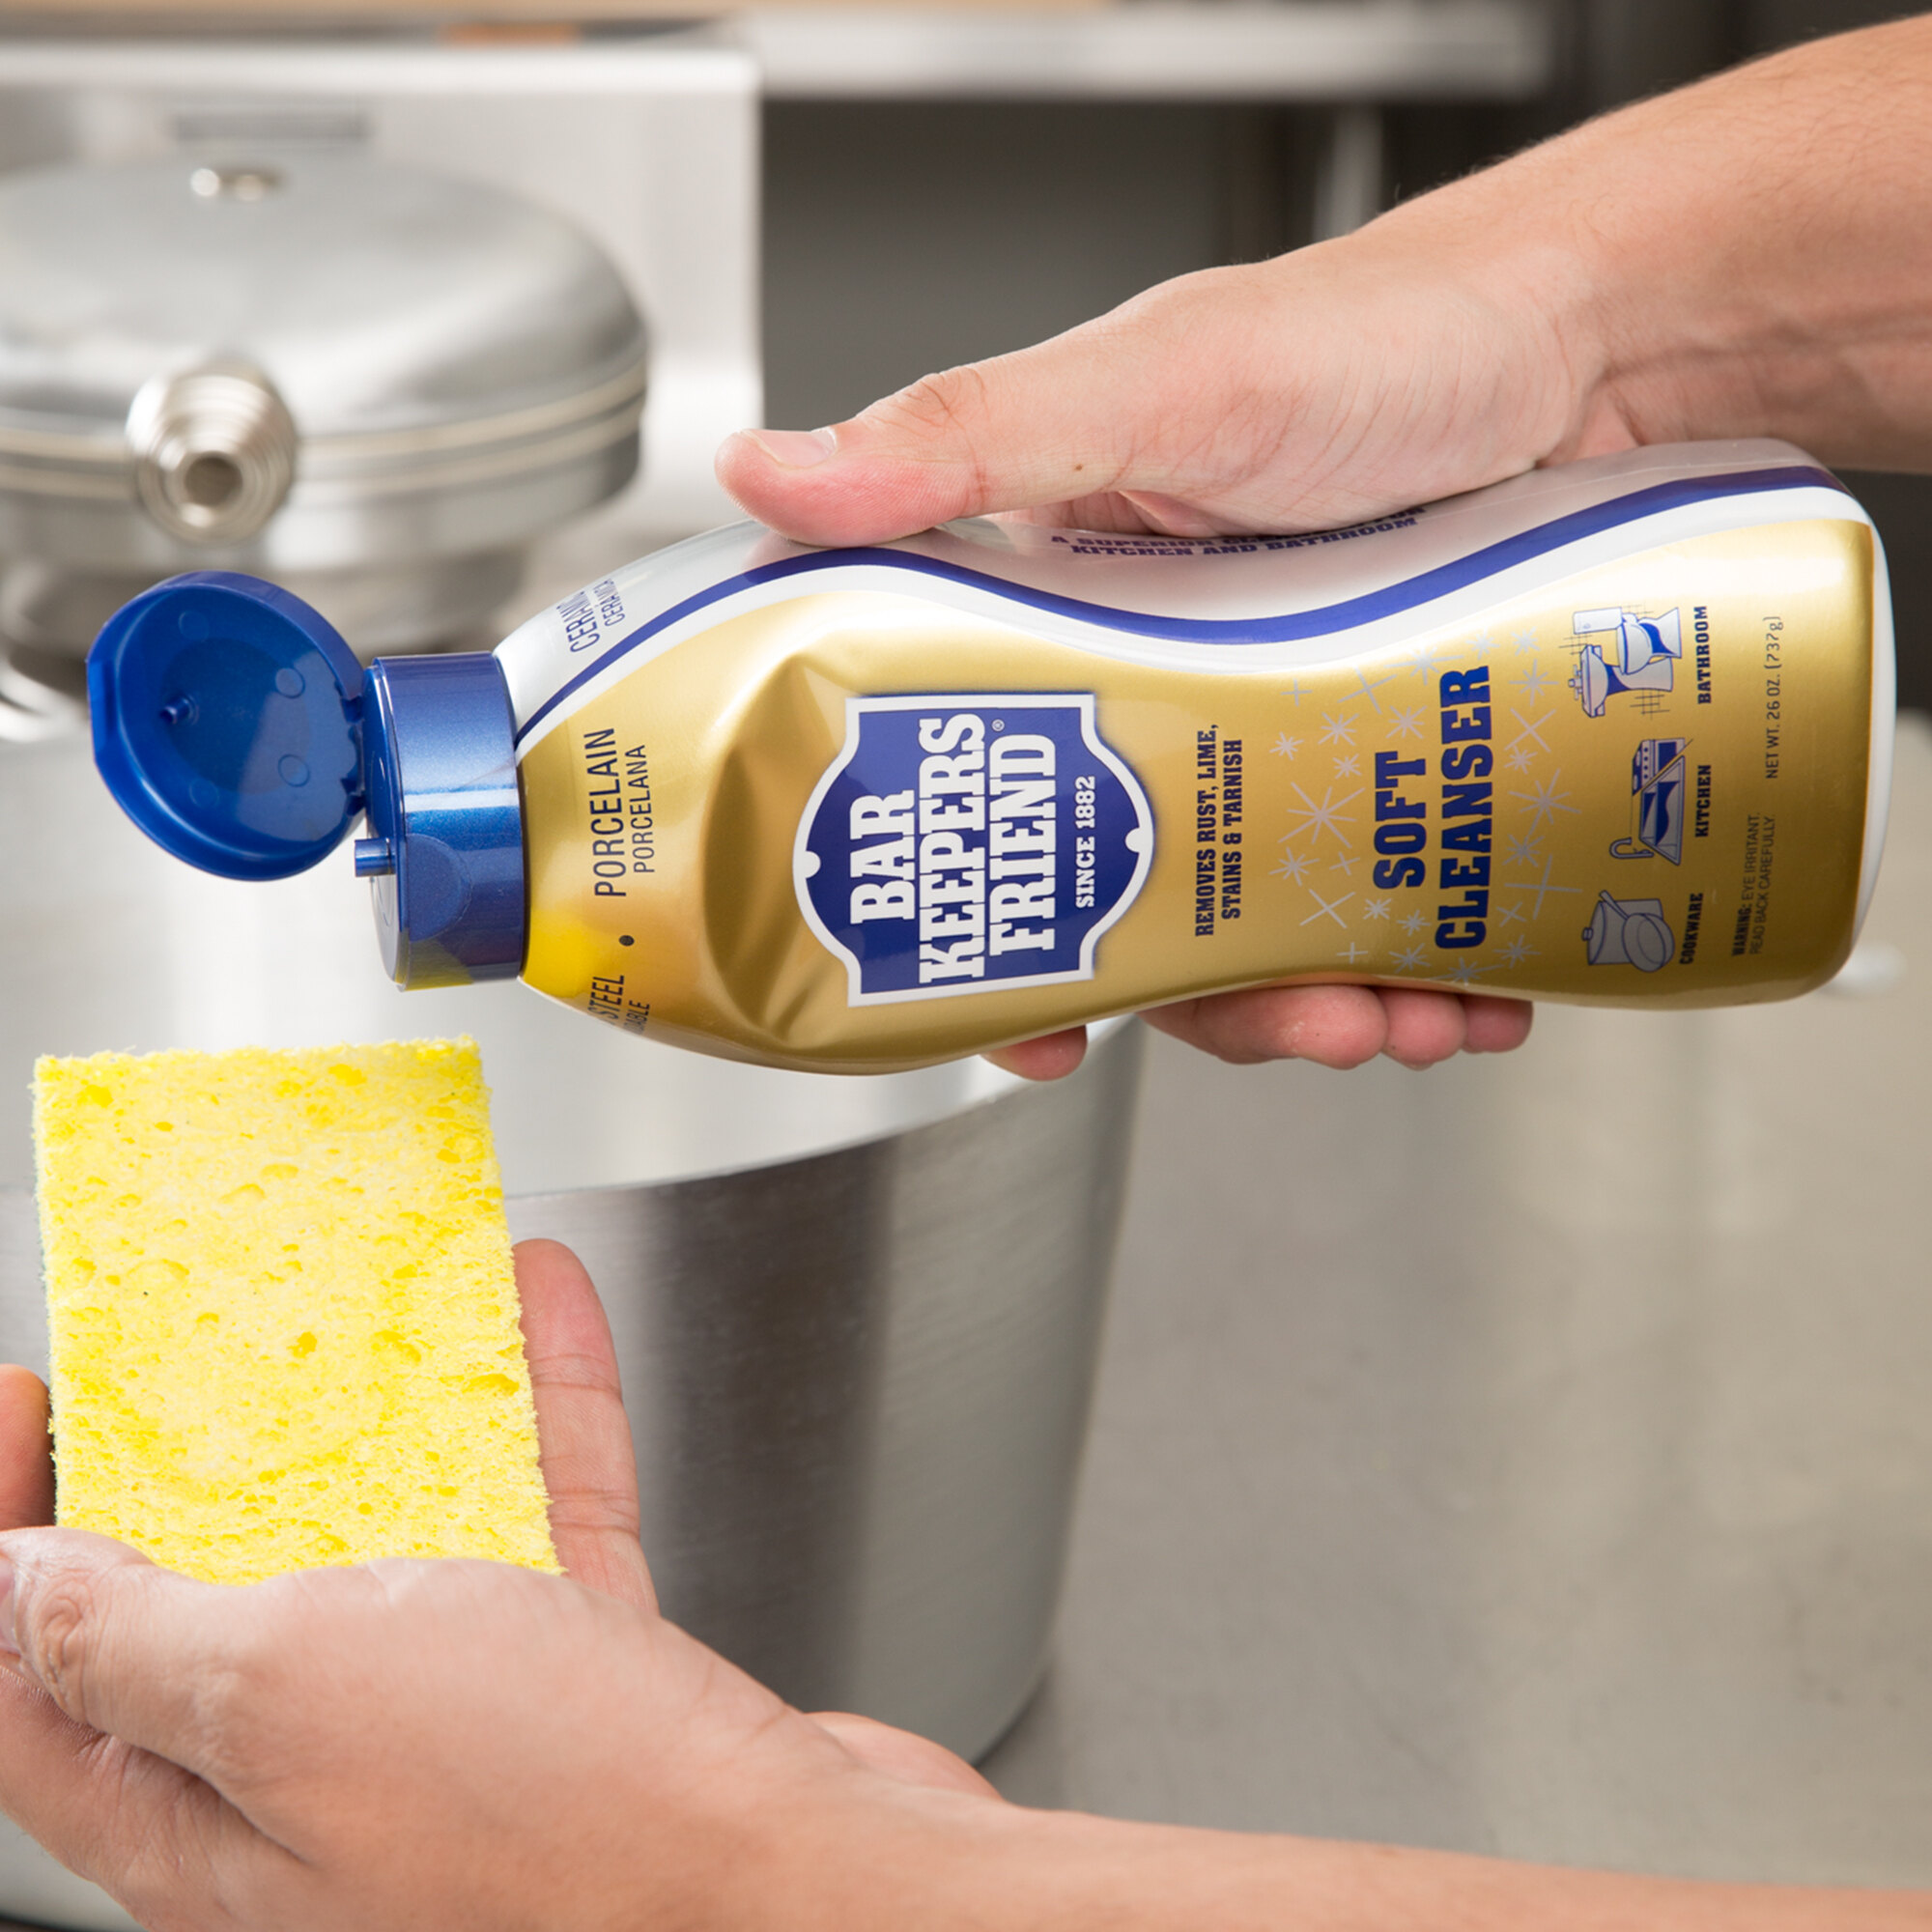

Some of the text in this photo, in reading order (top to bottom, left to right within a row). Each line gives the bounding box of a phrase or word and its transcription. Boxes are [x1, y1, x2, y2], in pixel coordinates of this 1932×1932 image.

[1070, 545, 1194, 556] KITCHEN
[1203, 543, 1258, 556] AND
[1265, 517, 1418, 551] BATHROOM
[1076, 537, 1213, 548] SUPERIOR
[1693, 606, 1712, 704] BATHROOM
[1763, 616, 1784, 779] NET WT. 26 OZ. (737g)
[583, 728, 626, 896] PORCELAIN
[625, 745, 655, 872] PORCELANA
[850, 789, 915, 923] BAR
[919, 714, 985, 983] KEEPERS
[1075, 776, 1095, 908] SINCE 1882
[1195, 724, 1219, 937] REMOVES RUST, LIME,
[1221, 740, 1243, 920] STAINS & TARNISH
[1373, 751, 1427, 889] SOFT
[1435, 666, 1493, 950] CLEANSER
[1695, 765, 1712, 838] KITCHEN
[1680, 893, 1703, 965] COOKWARE
[1732, 812, 1761, 956] WARNING: EYE IRRITANT.
[1749, 922, 1763, 954] READ
[1755, 893, 1770, 923] BACK
[587, 975, 624, 1019] STEEL
